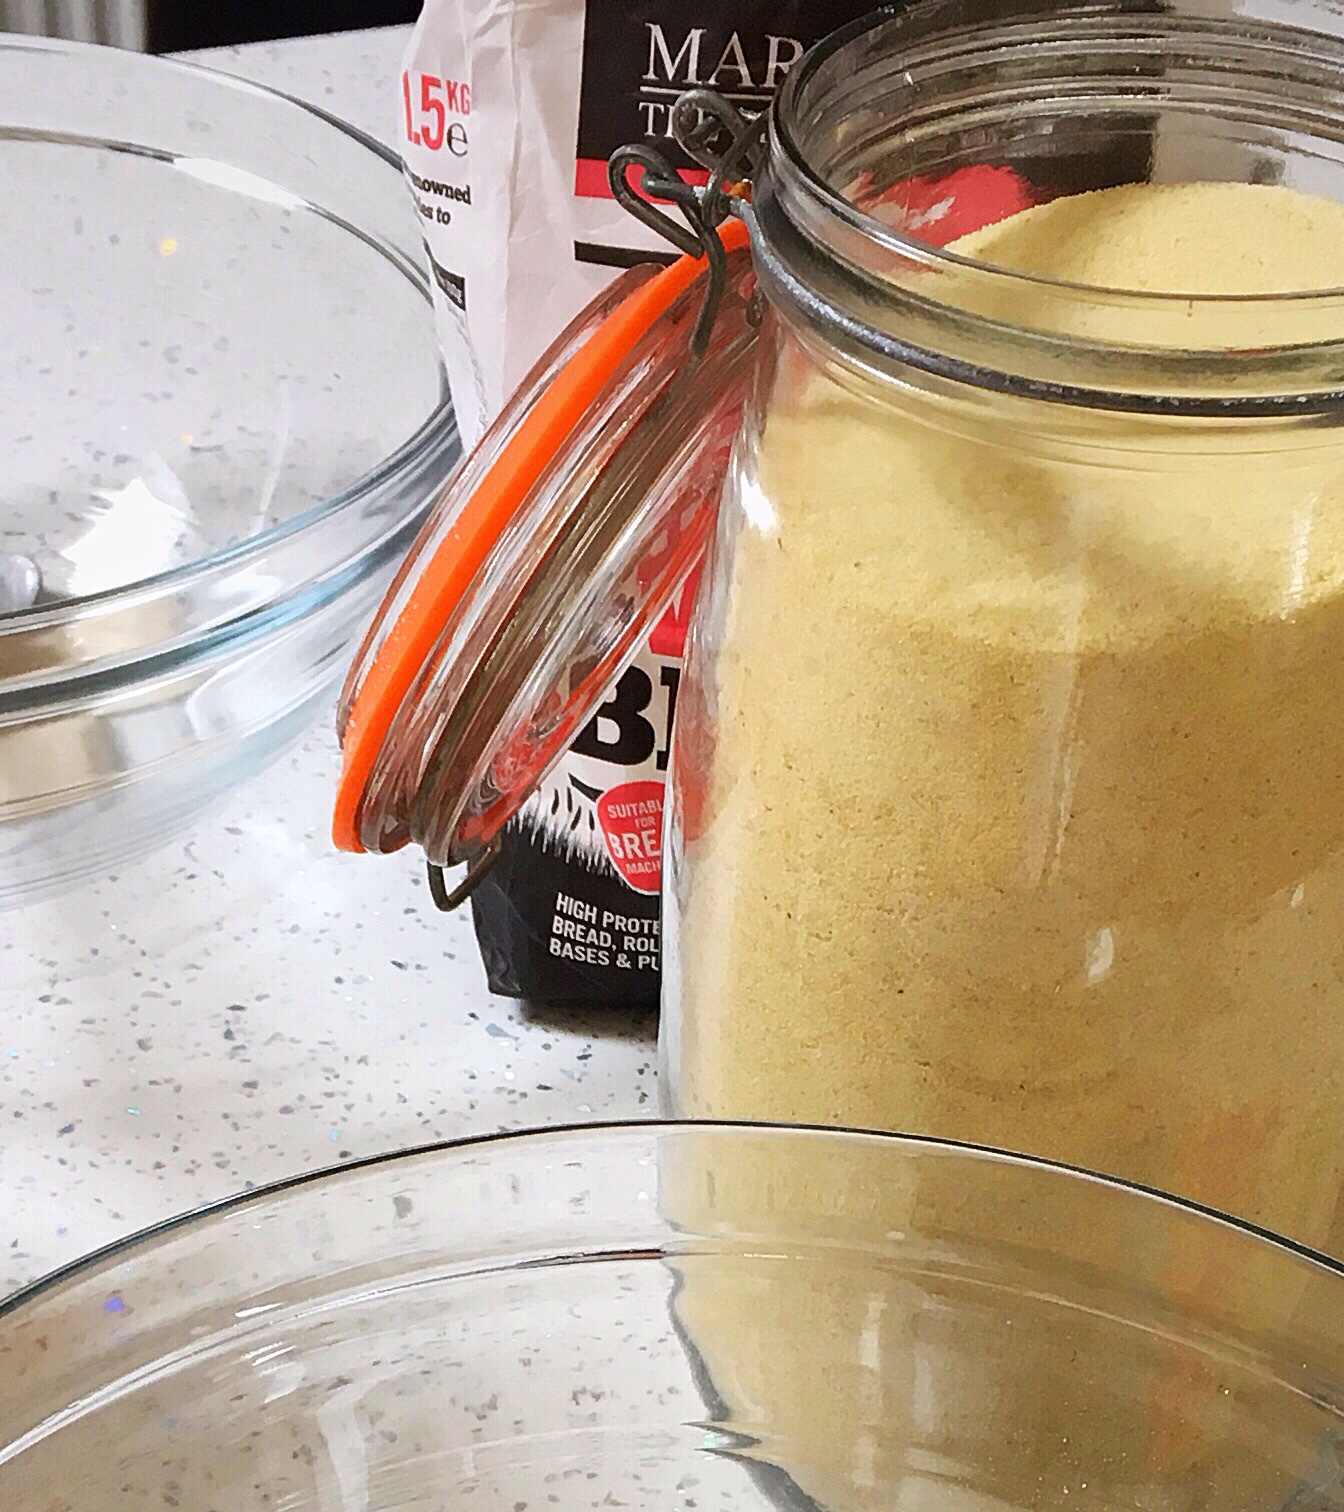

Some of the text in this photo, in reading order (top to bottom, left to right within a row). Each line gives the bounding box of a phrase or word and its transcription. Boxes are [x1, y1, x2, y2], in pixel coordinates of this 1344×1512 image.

[635, 816, 656, 829] FOR
[607, 829, 661, 862] BRE
[556, 892, 598, 925] HIGH
[552, 915, 617, 951] BREAD,
[549, 937, 610, 966] BASES
[616, 953, 632, 969] &
